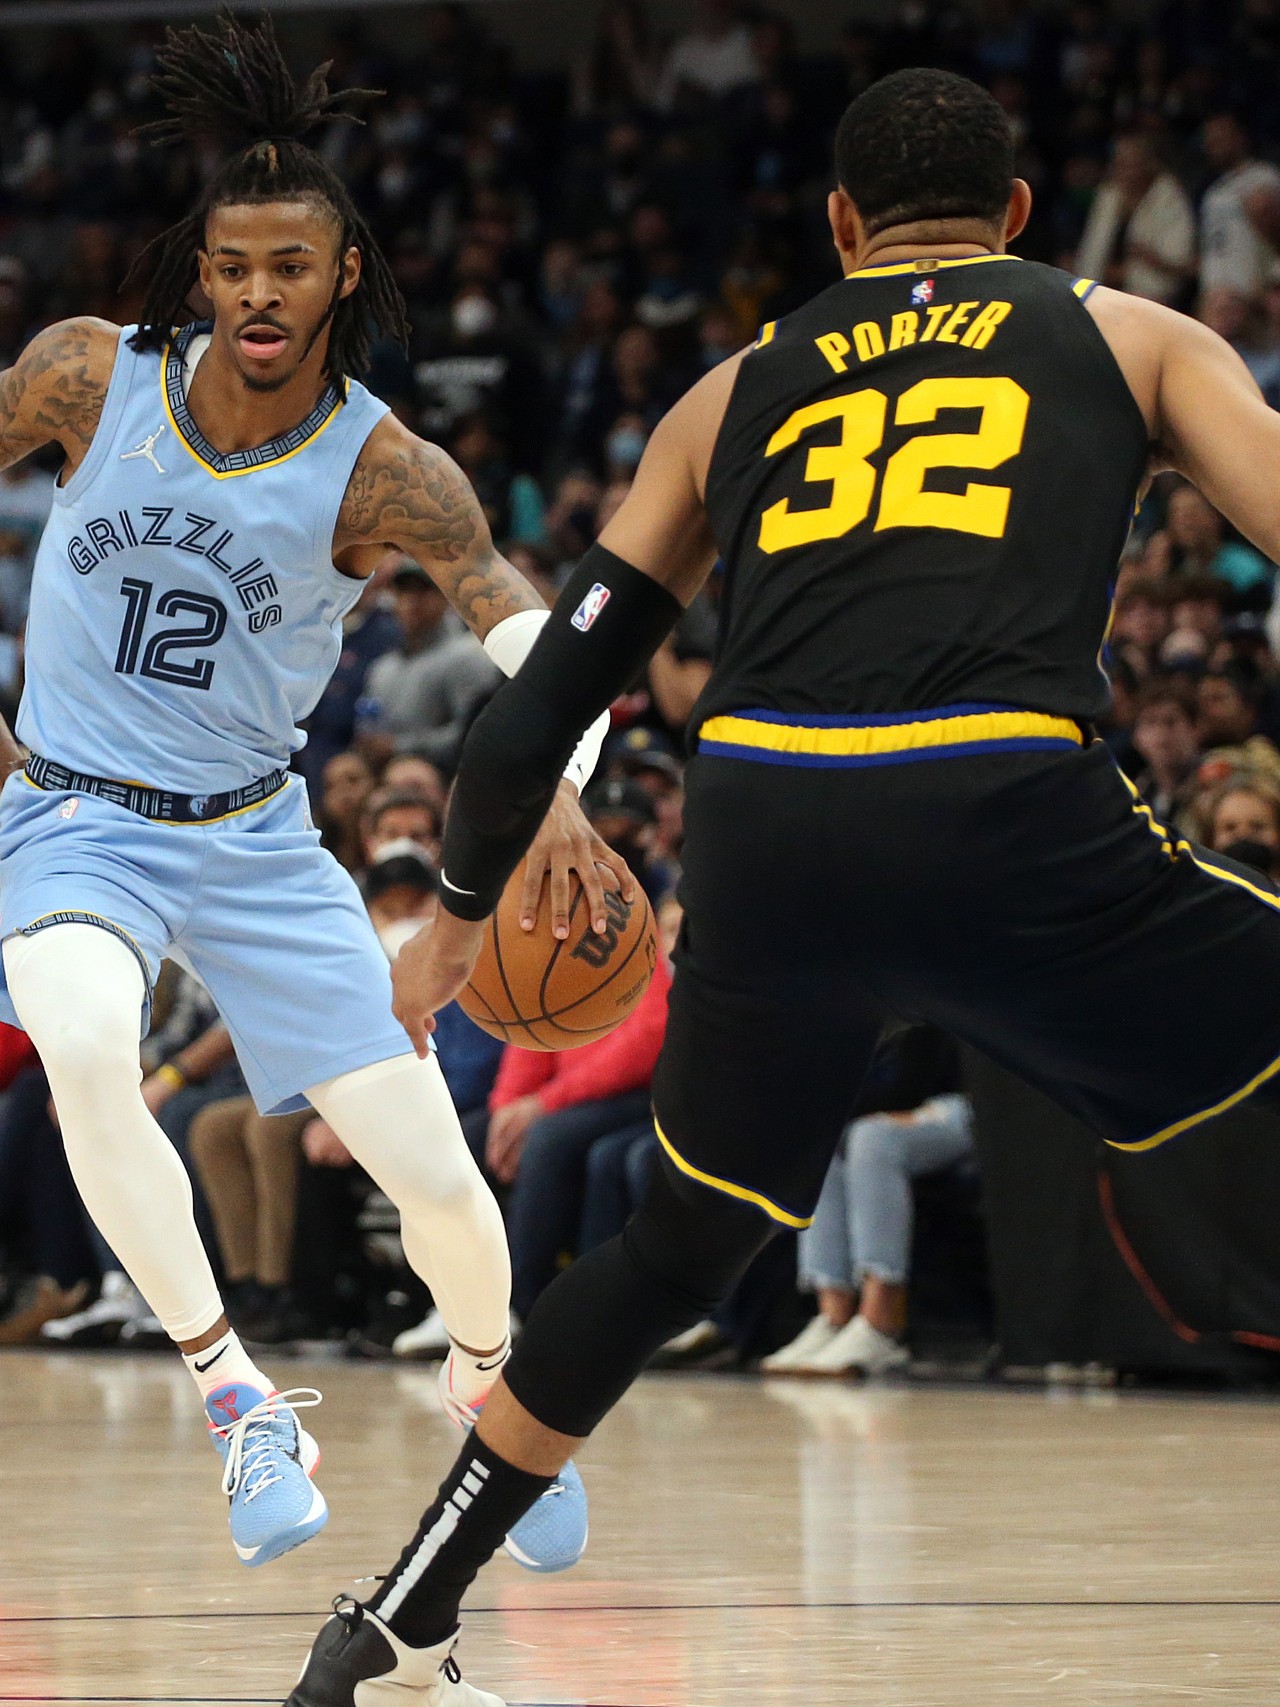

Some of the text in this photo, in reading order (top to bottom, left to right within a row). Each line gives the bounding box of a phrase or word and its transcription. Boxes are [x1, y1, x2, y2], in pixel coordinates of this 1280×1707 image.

[814, 300, 1014, 374] PORTER
[757, 377, 1030, 554] 32
[67, 506, 282, 633] GRIZZLIES
[114, 576, 228, 690] 12
[570, 889, 633, 968] Wil
